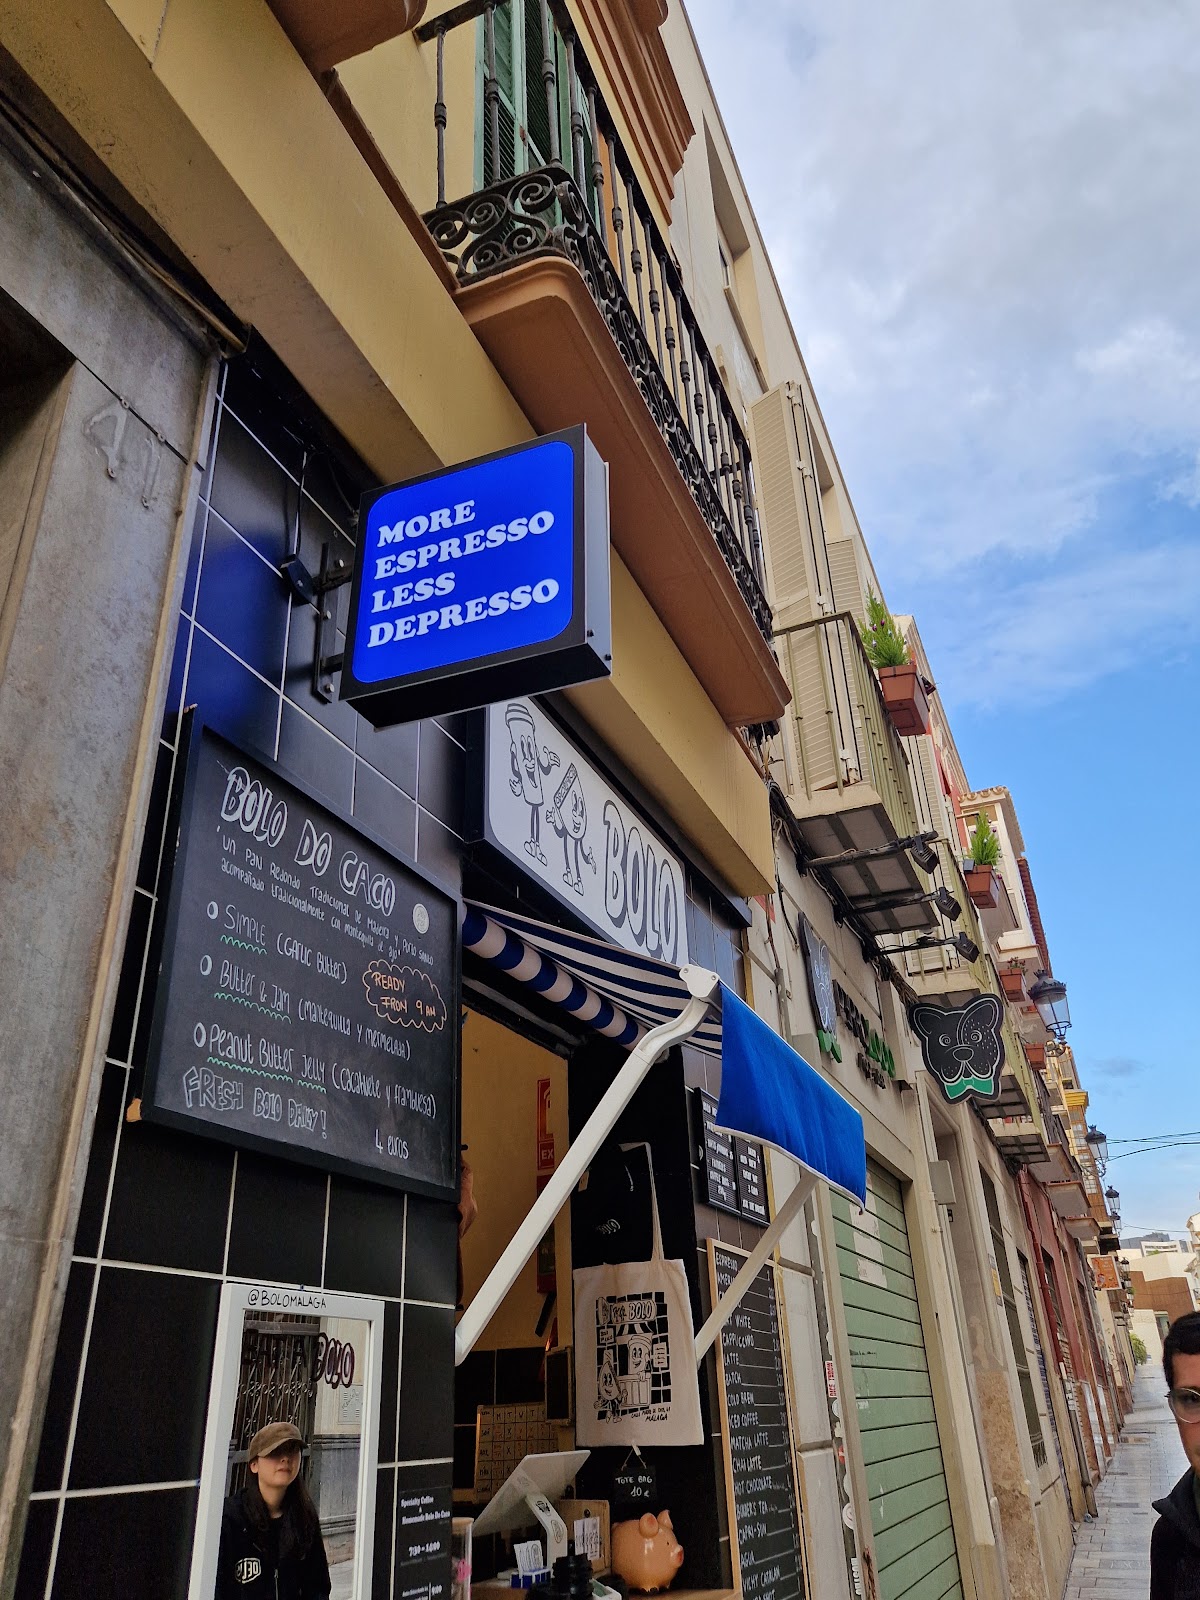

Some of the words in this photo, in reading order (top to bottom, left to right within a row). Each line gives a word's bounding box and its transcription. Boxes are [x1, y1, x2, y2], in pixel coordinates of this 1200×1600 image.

[377, 499, 476, 548] MORE
[373, 511, 555, 580] ESPRESSO
[367, 578, 560, 648] DEPRESSO
[371, 571, 456, 613] LESS
[221, 766, 288, 848] BOLO
[294, 818, 332, 877] DO
[339, 850, 396, 917] CACO
[603, 799, 679, 965] BOLO
[223, 904, 266, 946] SIMPLE
[371, 972, 406, 993] READY
[183, 1066, 244, 1111] FRESH
[253, 1087, 282, 1122] BOLO
[375, 1128, 383, 1154] 4
[387, 1134, 409, 1160] euros
[247, 1288, 327, 1309] @BOLOMALAGA
[629, 1300, 653, 1321] BOLO
[615, 1476, 635, 1485] TOTE
